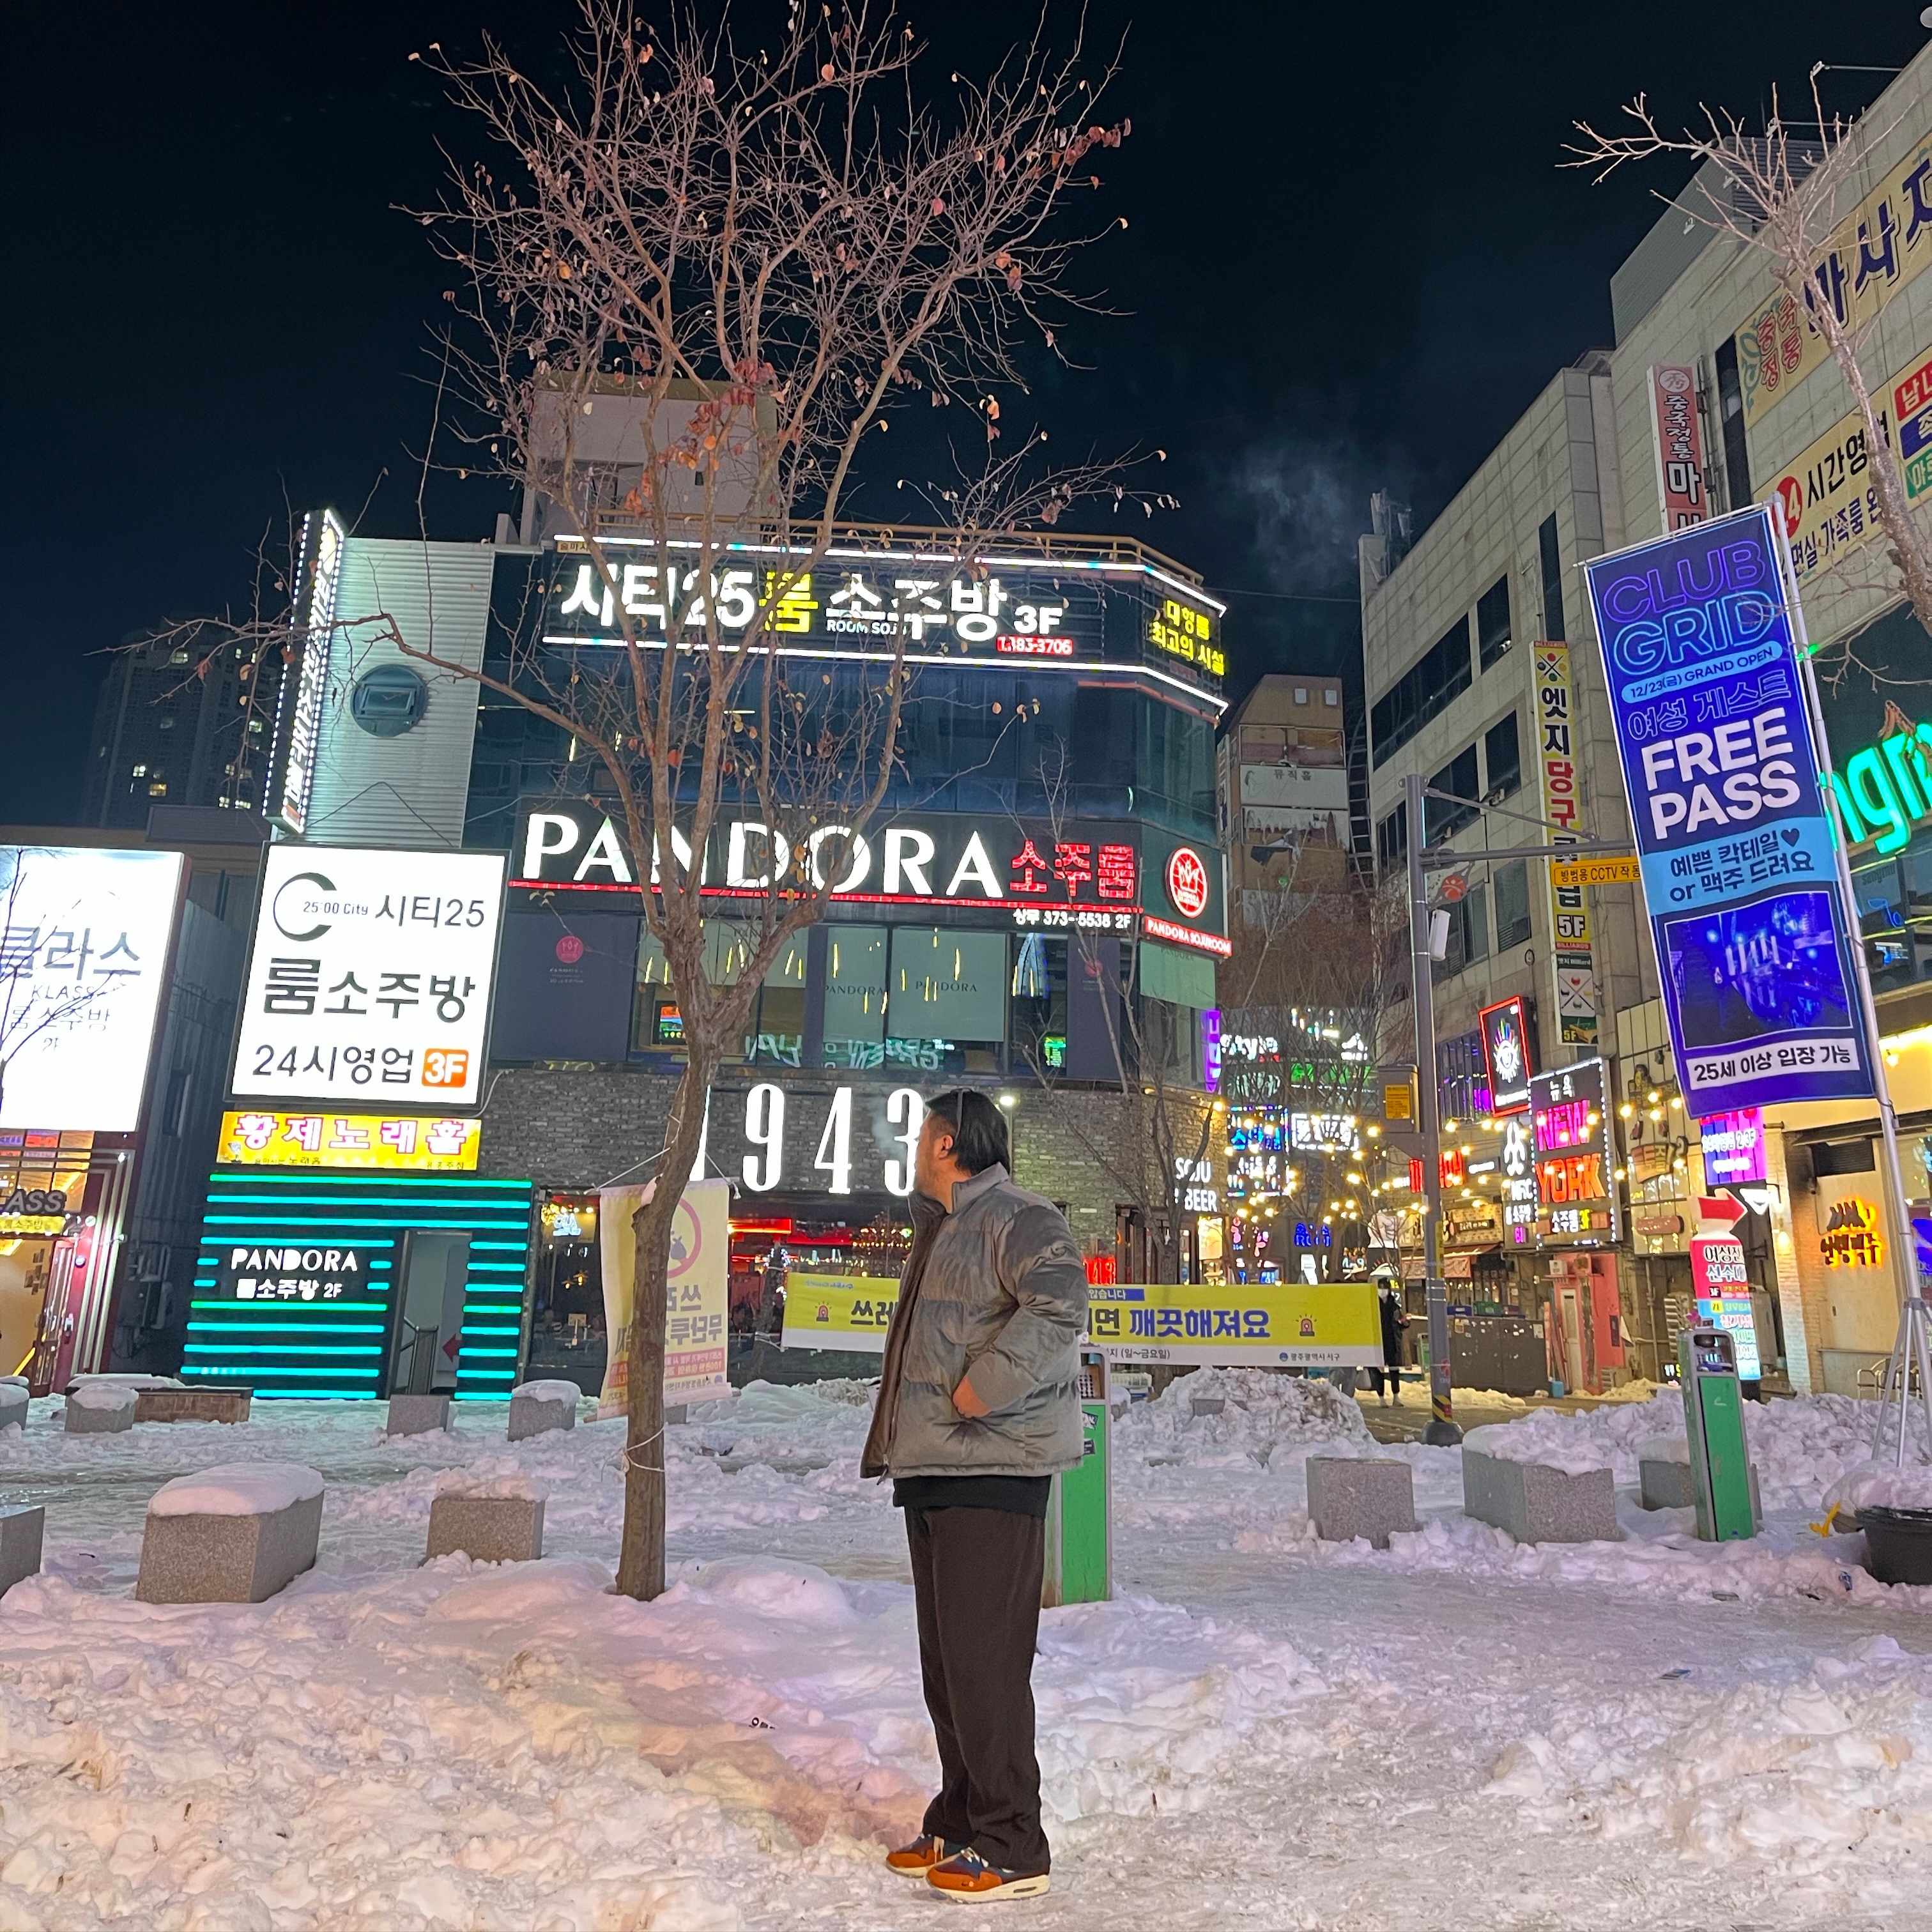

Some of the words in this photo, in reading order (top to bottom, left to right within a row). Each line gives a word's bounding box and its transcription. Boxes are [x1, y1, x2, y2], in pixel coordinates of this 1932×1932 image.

[1603, 540, 1766, 624] CLUB
[871, 622, 907, 638] SOJ
[1014, 606, 1064, 635] 3F
[1613, 590, 1776, 675] GRID
[1684, 660, 1735, 682] GRAND
[1737, 646, 1774, 670] OPEN
[1628, 698, 1689, 741] 여성
[1694, 669, 1792, 722] 게스트
[1641, 707, 1794, 791] FREE
[1649, 760, 1801, 841] PASS
[1009, 840, 1135, 899] 소주룸
[1591, 866, 1618, 881] CCTV
[1670, 849, 1714, 879] 예쁜
[1718, 830, 1778, 865] 칵테일
[1669, 884, 1695, 902] or
[1700, 870, 1745, 894] 맥주
[1750, 850, 1814, 883] 드려요
[343, 903, 369, 916] City
[374, 894, 484, 928] 시티25
[1114, 914, 1131, 929] 2F
[1556, 914, 1586, 938] 5F
[1147, 920, 1189, 942] PANDORA
[0, 926, 141, 981] 클라스
[263, 958, 476, 1023] 룸소주방
[825, 985, 885, 995] PANDORA
[916, 980, 977, 993] PNDORA
[1563, 1029, 1576, 1041] 5F
[252, 1045, 414, 1084] 24시영업
[424, 1052, 467, 1081] 3F
[1693, 1055, 1736, 1083] 25세
[1740, 1050, 1772, 1075] 이상
[1777, 1045, 1816, 1067] 입장
[1821, 1044, 1851, 1064] 가능
[234, 1114, 468, 1155] 황제노래홀
[689, 1082, 921, 1197] 943
[1536, 1100, 1591, 1151] NEW
[1533, 1153, 1606, 1203] YORK
[0, 1189, 65, 1213] ASS
[230, 1248, 358, 1271] PANDORA
[323, 1283, 342, 1298] 2F
[1130, 1308, 1271, 1338] 깨끗해져요
